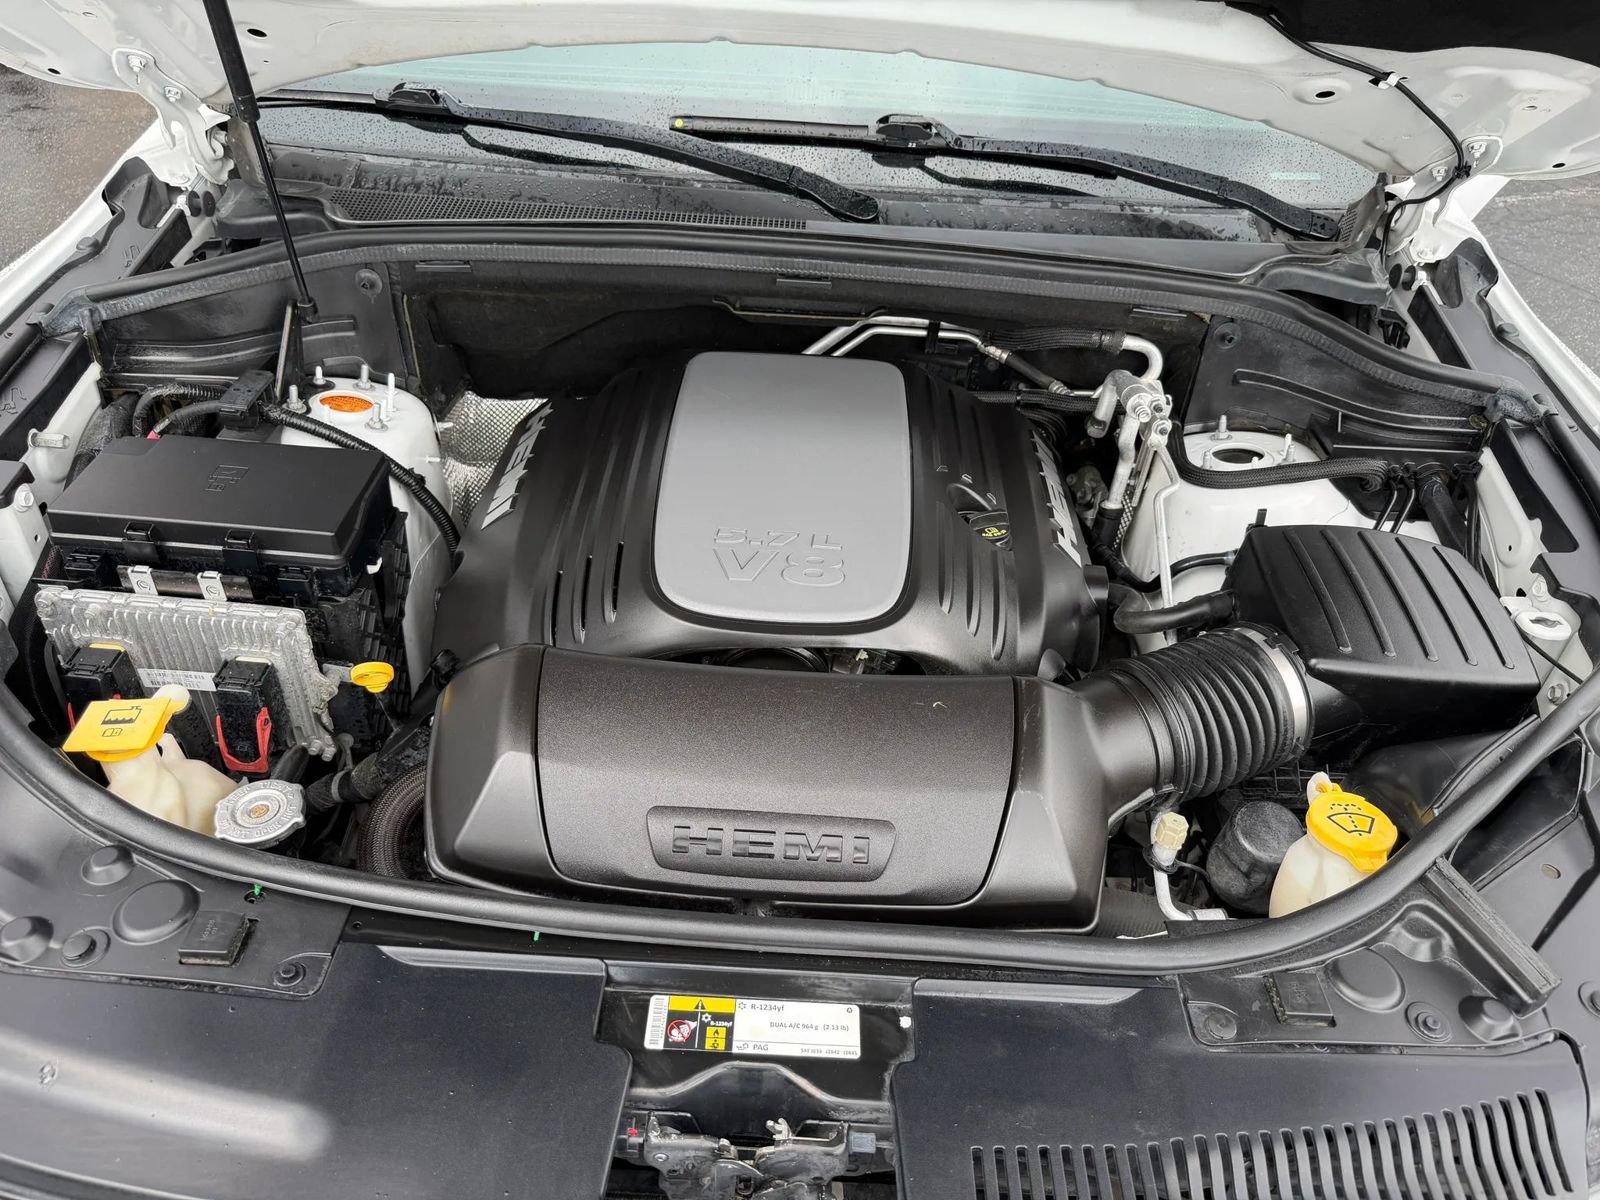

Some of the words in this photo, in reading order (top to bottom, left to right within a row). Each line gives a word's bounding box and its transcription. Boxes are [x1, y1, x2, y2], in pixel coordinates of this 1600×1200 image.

[712, 547, 847, 588] V8
[671, 825, 871, 864] HEMI
[750, 1003, 785, 1013] R-1234yf
[769, 1021, 788, 1029] DUAL
[788, 1022, 801, 1030] A/C
[823, 1023, 840, 1031] (2.13
[752, 1043, 770, 1051] PAG
